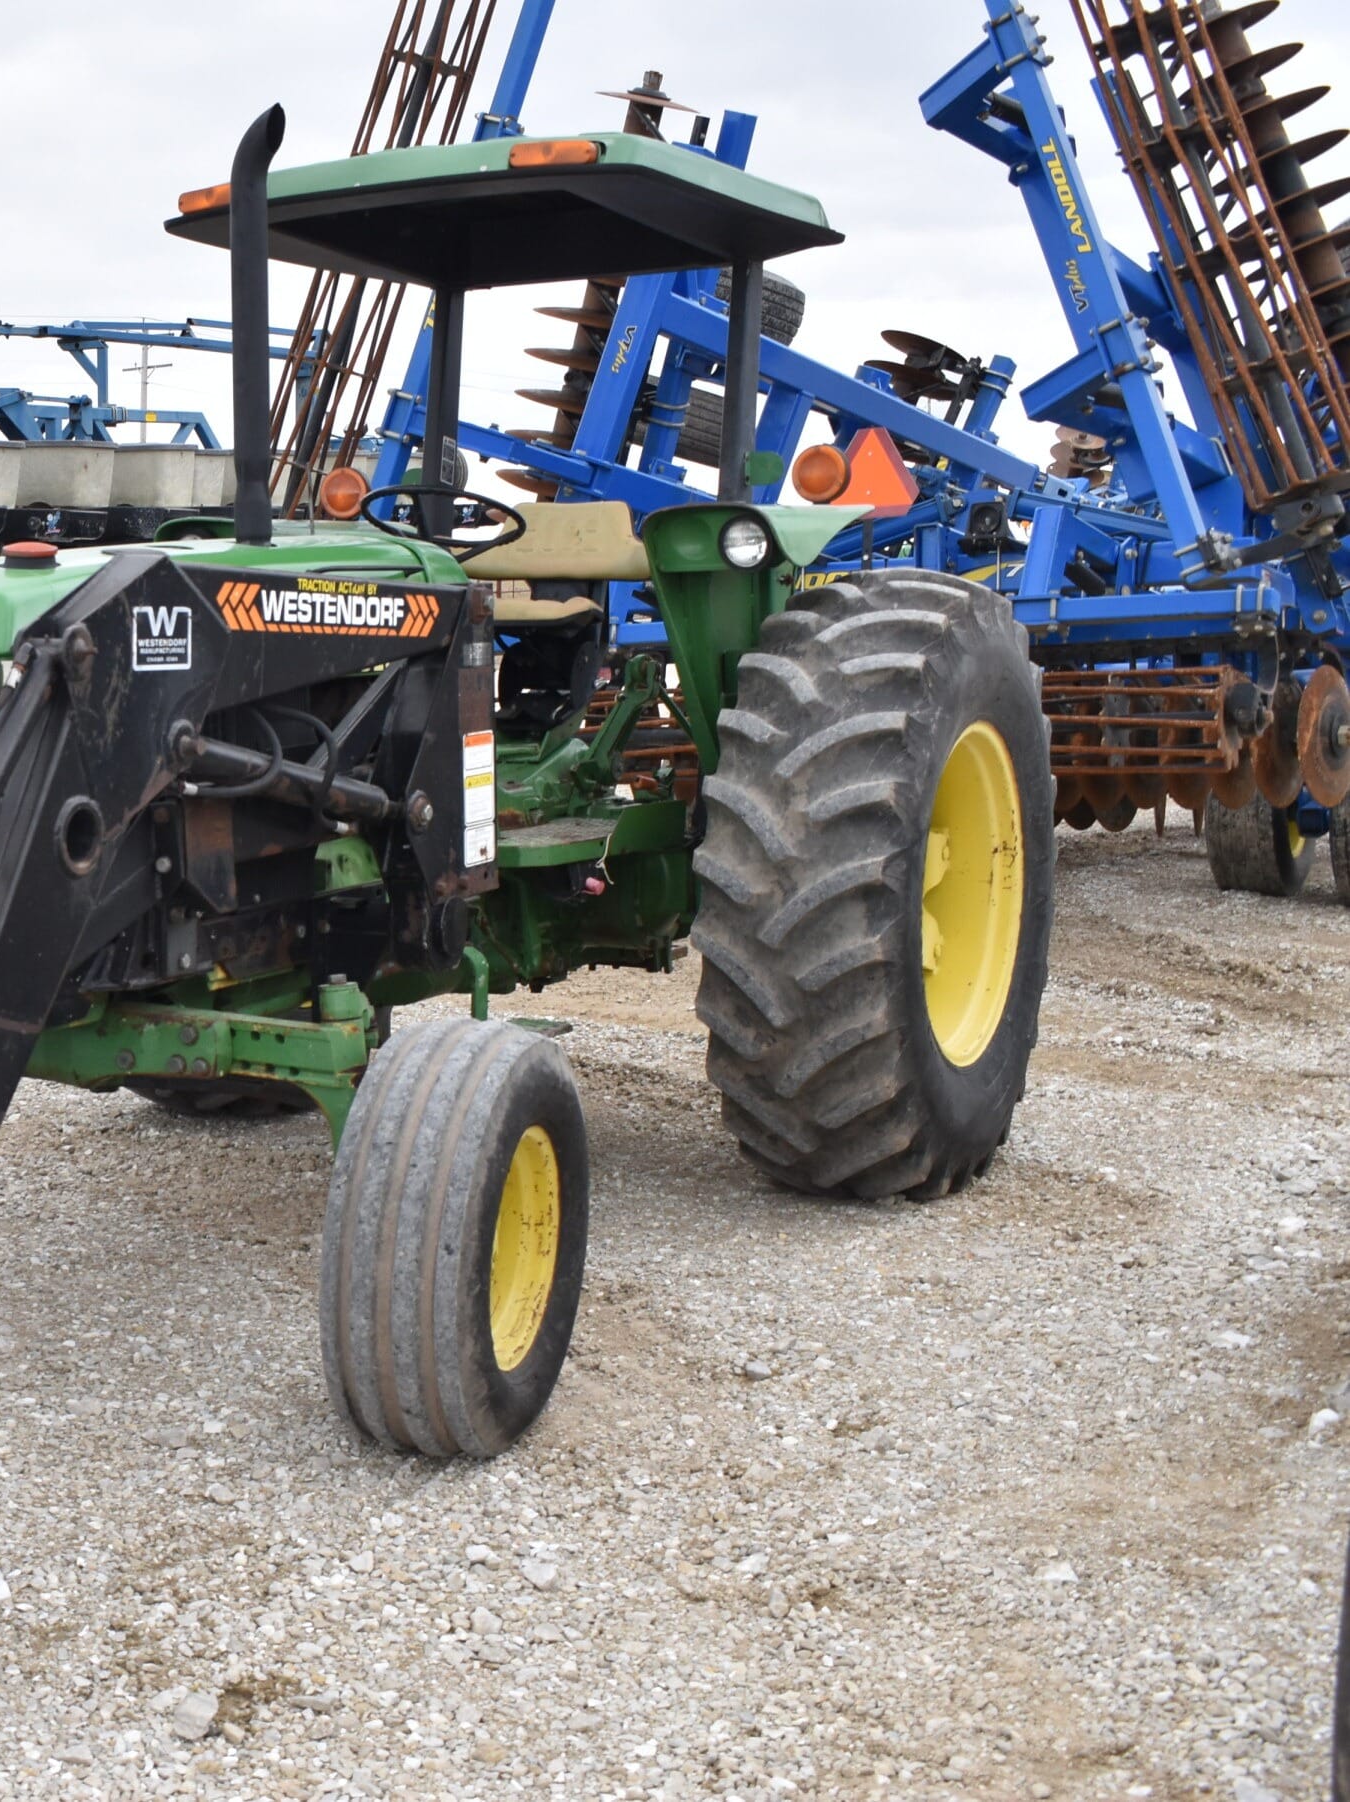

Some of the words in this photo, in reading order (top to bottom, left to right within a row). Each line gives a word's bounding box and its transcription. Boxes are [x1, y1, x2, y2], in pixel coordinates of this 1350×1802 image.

[1041, 136, 1092, 253] LANDOLL
[297, 578, 336, 593] TRACTION
[367, 582, 379, 596] BY
[260, 589, 405, 627] WESTENDORF
[137, 638, 187, 648] WESTENDORF
